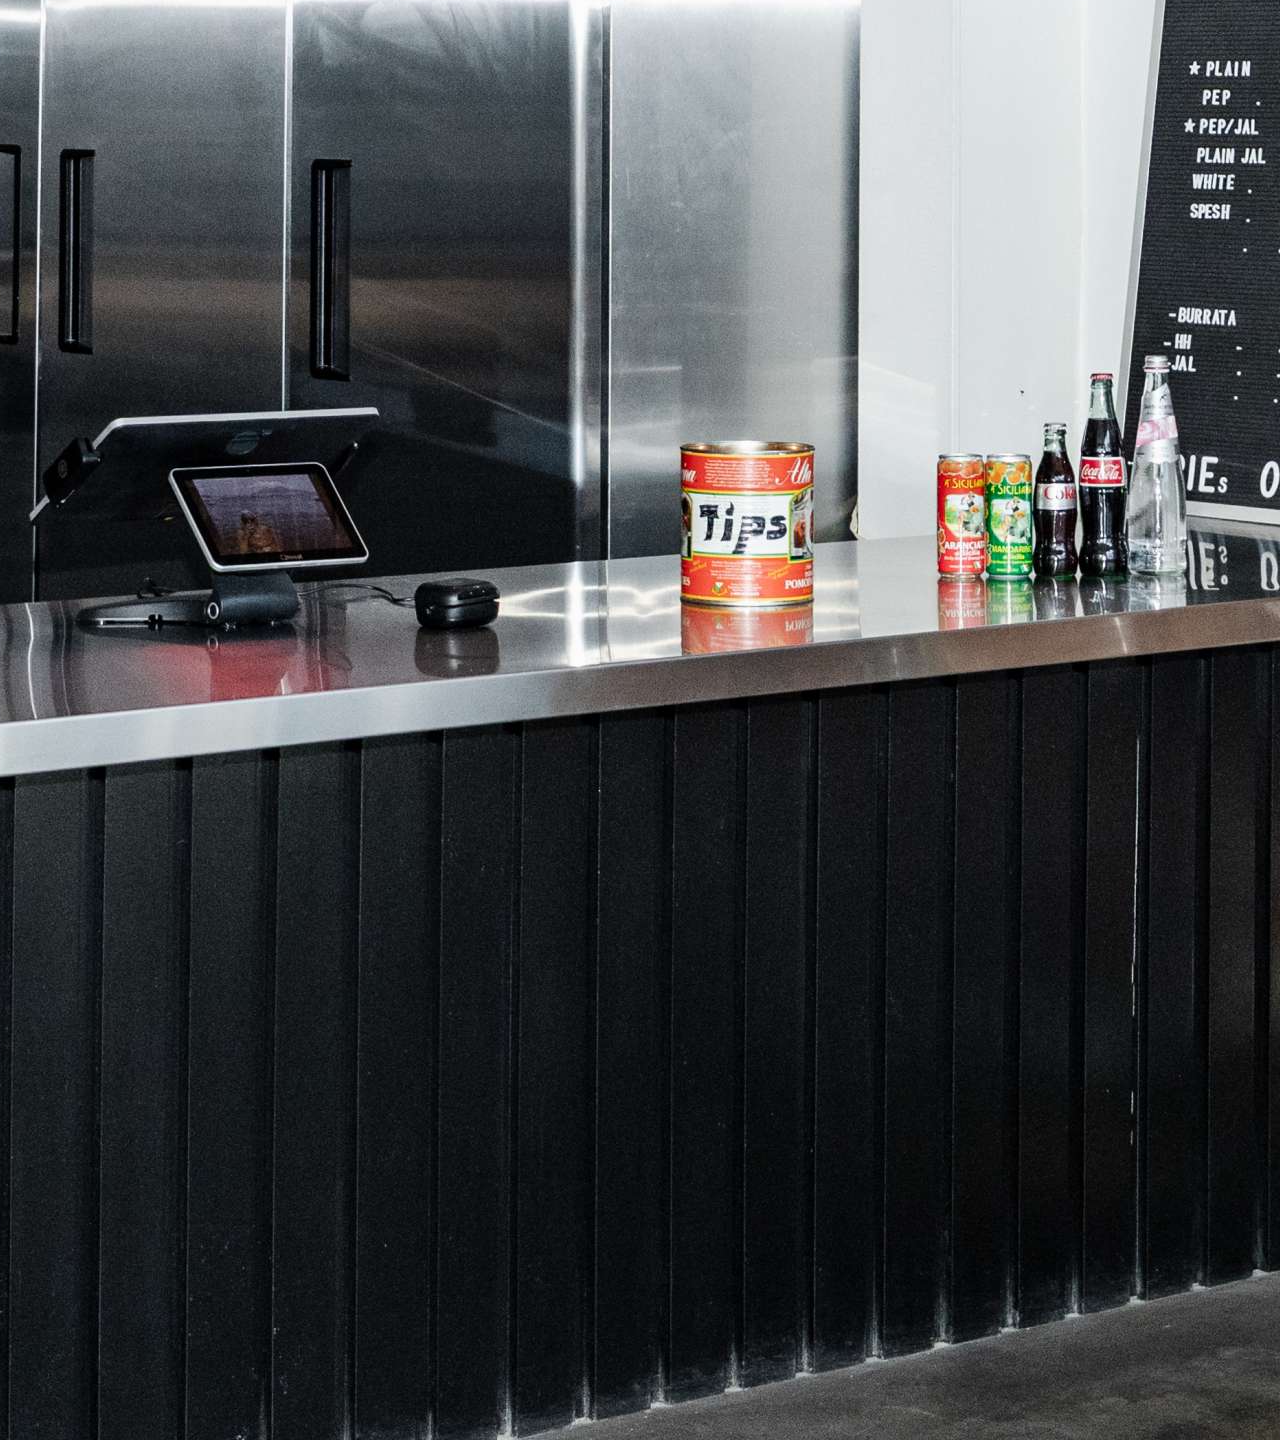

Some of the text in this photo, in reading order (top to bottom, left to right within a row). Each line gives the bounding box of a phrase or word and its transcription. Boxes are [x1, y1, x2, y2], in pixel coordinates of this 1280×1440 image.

[1205, 60, 1251, 78] PLAIN
[1202, 89, 1231, 106] PEP
[1198, 118, 1259, 136] PEP/JAL
[1196, 147, 1235, 164] PLAIN
[1240, 147, 1266, 165] JAL
[1192, 173, 1236, 191] WHITE
[1189, 203, 1231, 220] SPESH
[699, 501, 787, 554] Tips
